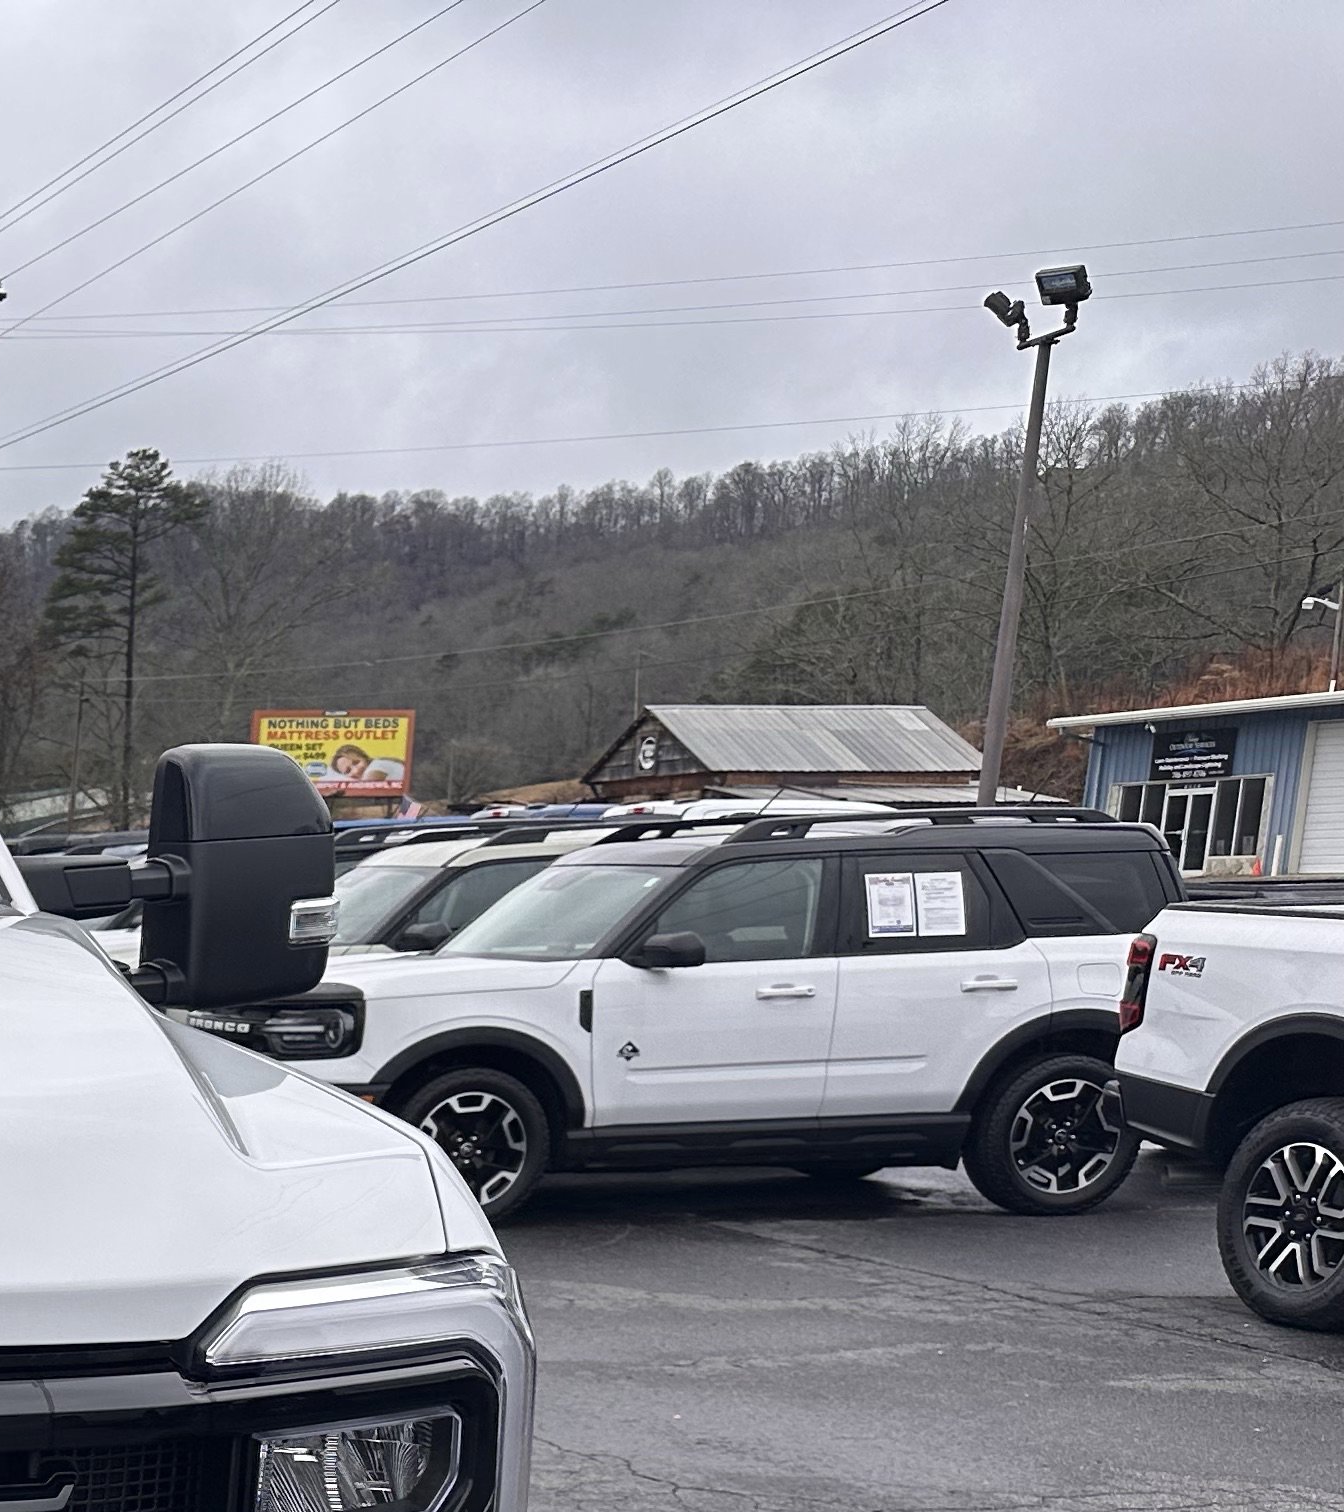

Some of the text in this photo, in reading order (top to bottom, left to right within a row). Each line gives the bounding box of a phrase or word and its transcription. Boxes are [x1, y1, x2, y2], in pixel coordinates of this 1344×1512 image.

[267, 718, 399, 729] NOTHING BUT BEDS
[267, 729, 398, 740] MATTRESS OUTLET
[305, 743, 324, 751] SET
[1158, 953, 1206, 972] FX4
[189, 1017, 250, 1034] BRONCO
